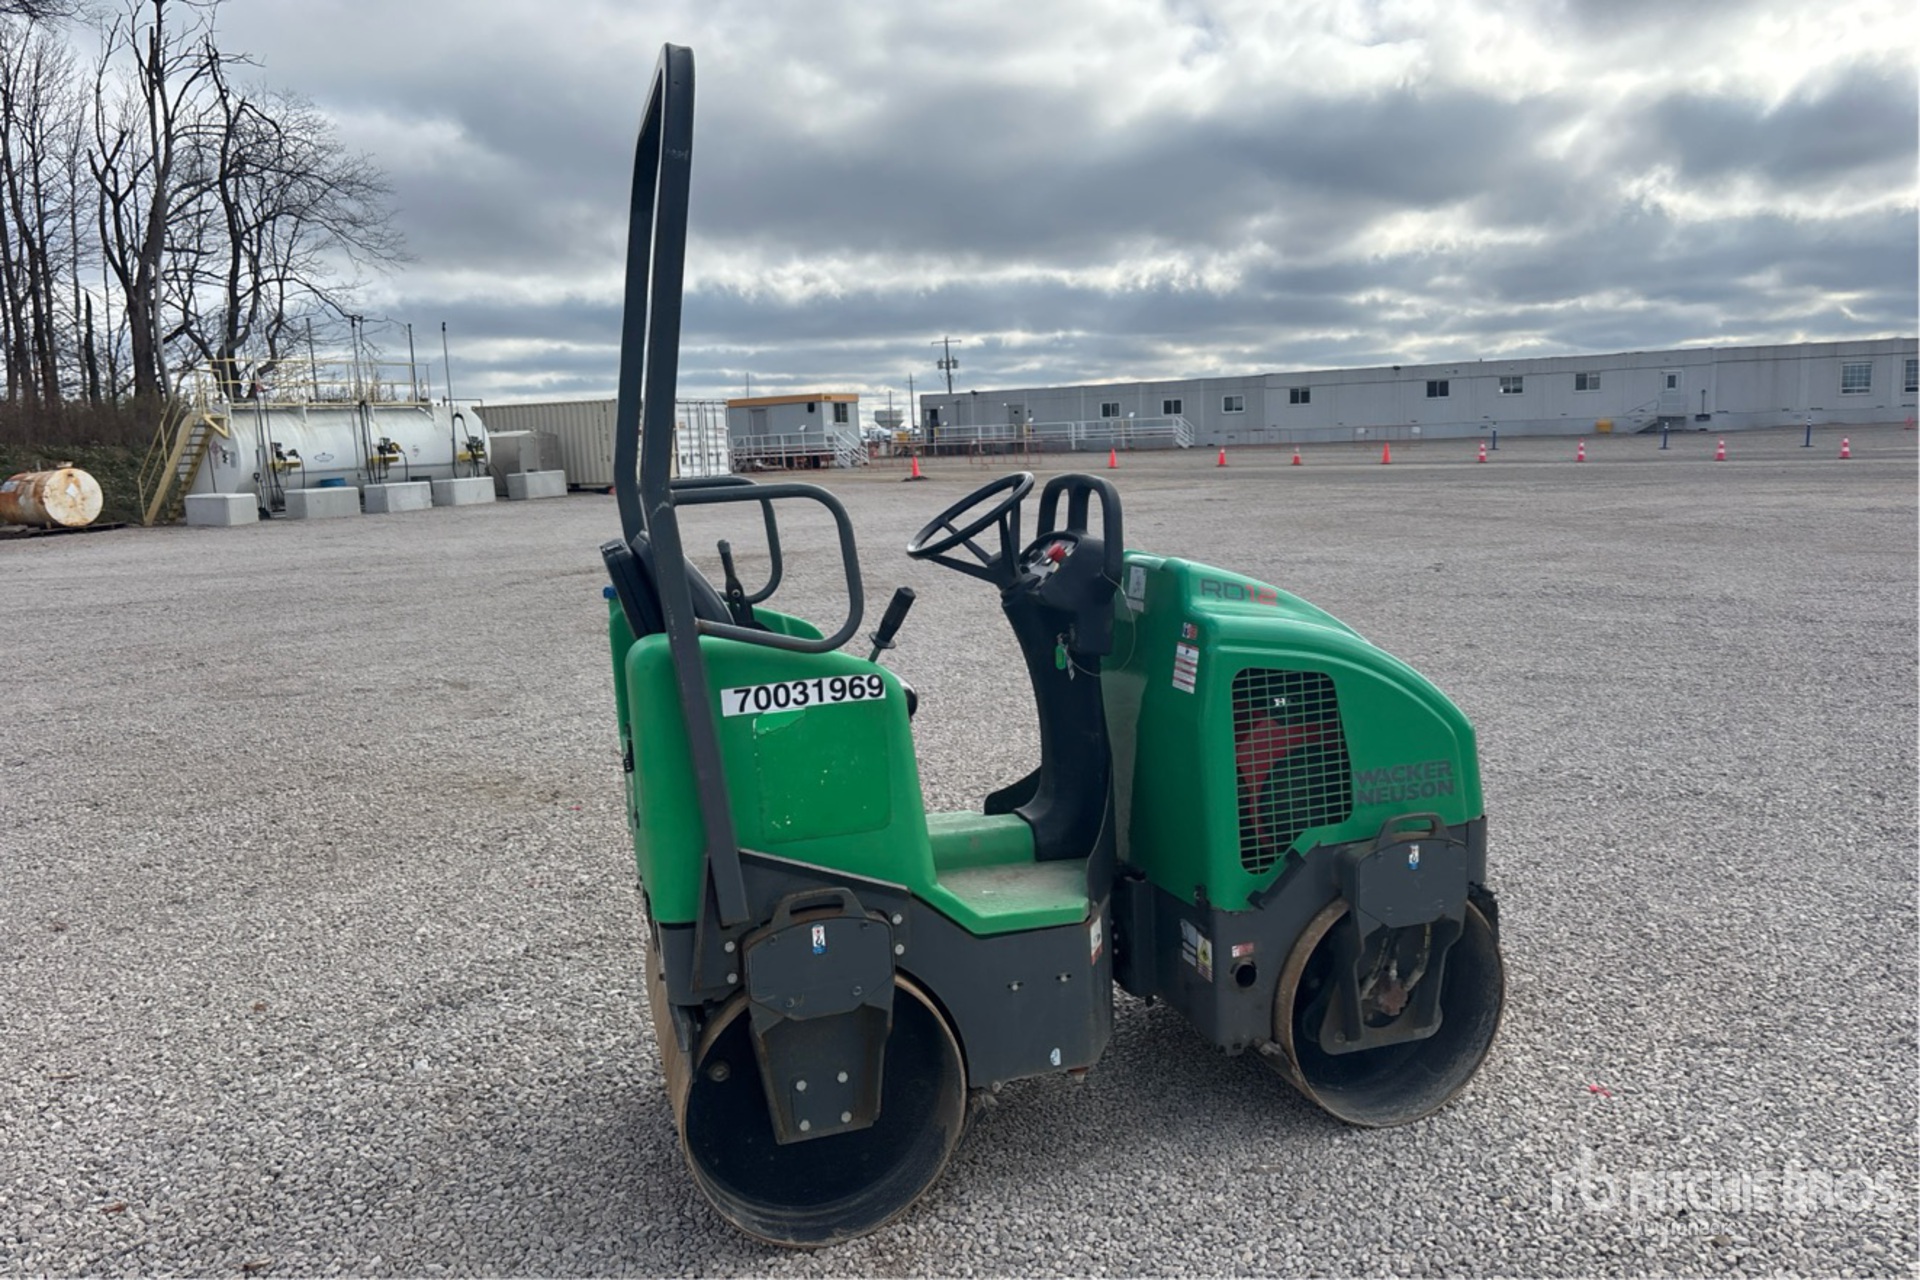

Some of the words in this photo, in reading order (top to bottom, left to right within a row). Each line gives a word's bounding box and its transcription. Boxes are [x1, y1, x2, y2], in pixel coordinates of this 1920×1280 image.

[1201, 579, 1277, 606] RD12
[733, 674, 884, 712] 70031969
[1355, 760, 1452, 786] WACKER
[1357, 780, 1453, 805] NEUSON
